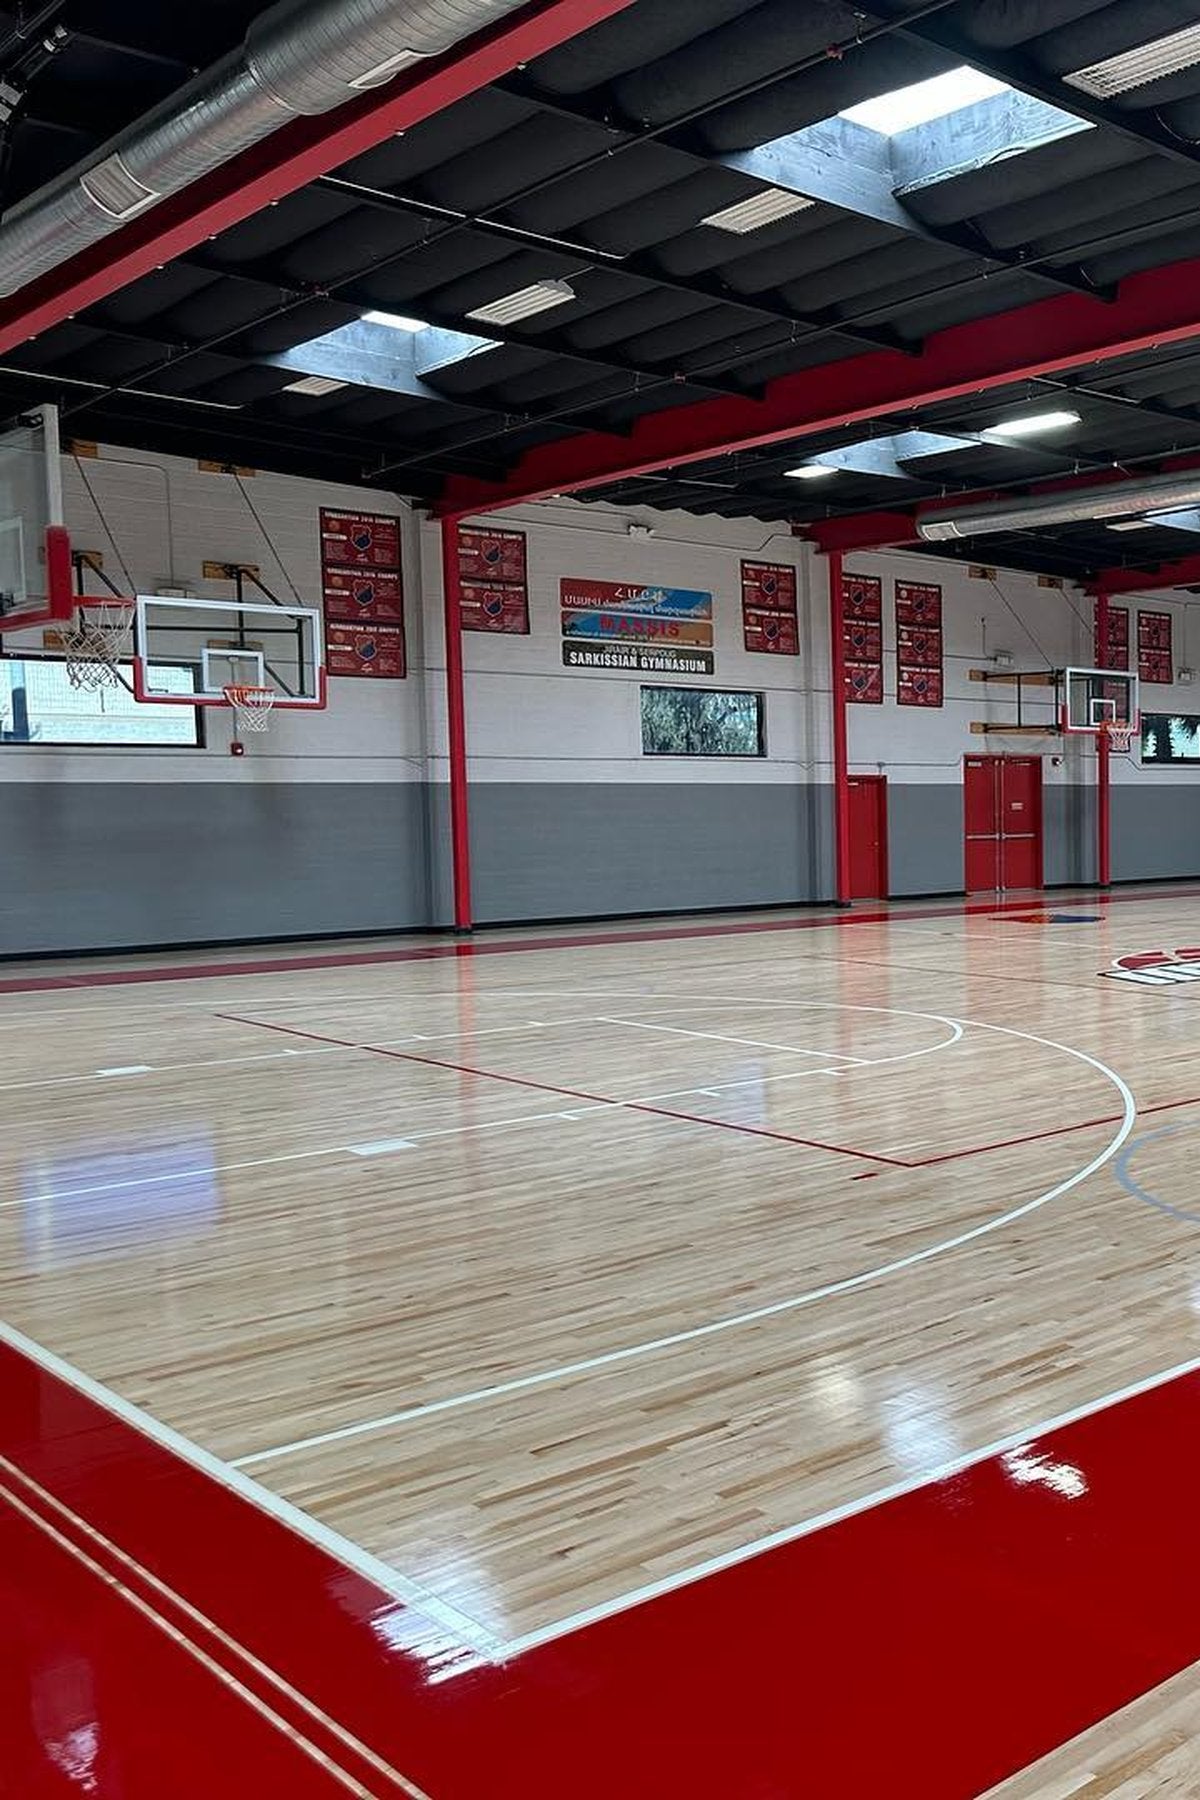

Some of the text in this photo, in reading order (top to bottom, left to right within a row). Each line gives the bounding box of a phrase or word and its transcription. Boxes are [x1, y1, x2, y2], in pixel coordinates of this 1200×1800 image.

[600, 616, 681, 638] MASSIS
[569, 652, 706, 673] SARKISSIAN GYMNASIUM
